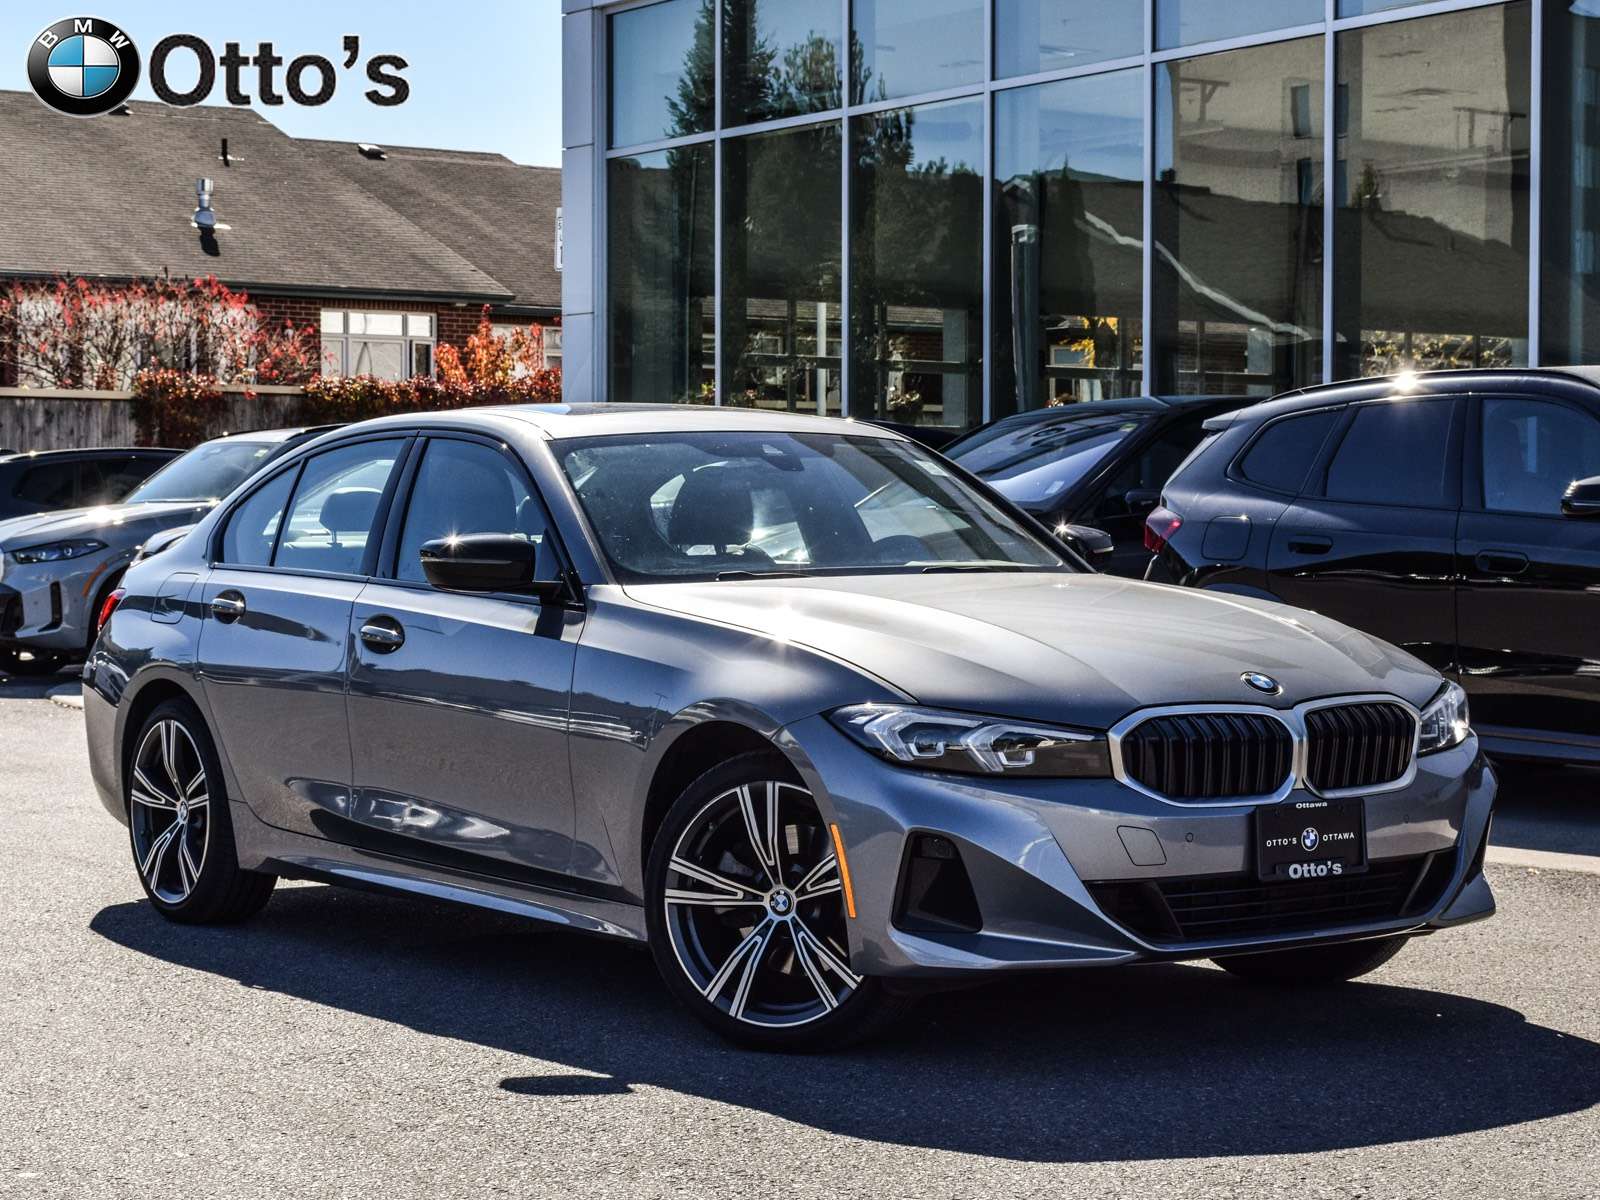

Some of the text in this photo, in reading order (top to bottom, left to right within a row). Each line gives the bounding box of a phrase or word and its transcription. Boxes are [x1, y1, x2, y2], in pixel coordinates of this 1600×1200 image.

[1266, 837, 1297, 847] OTTO'S
[1322, 832, 1355, 841] OTTAWA
[1288, 861, 1343, 879] Otto's
